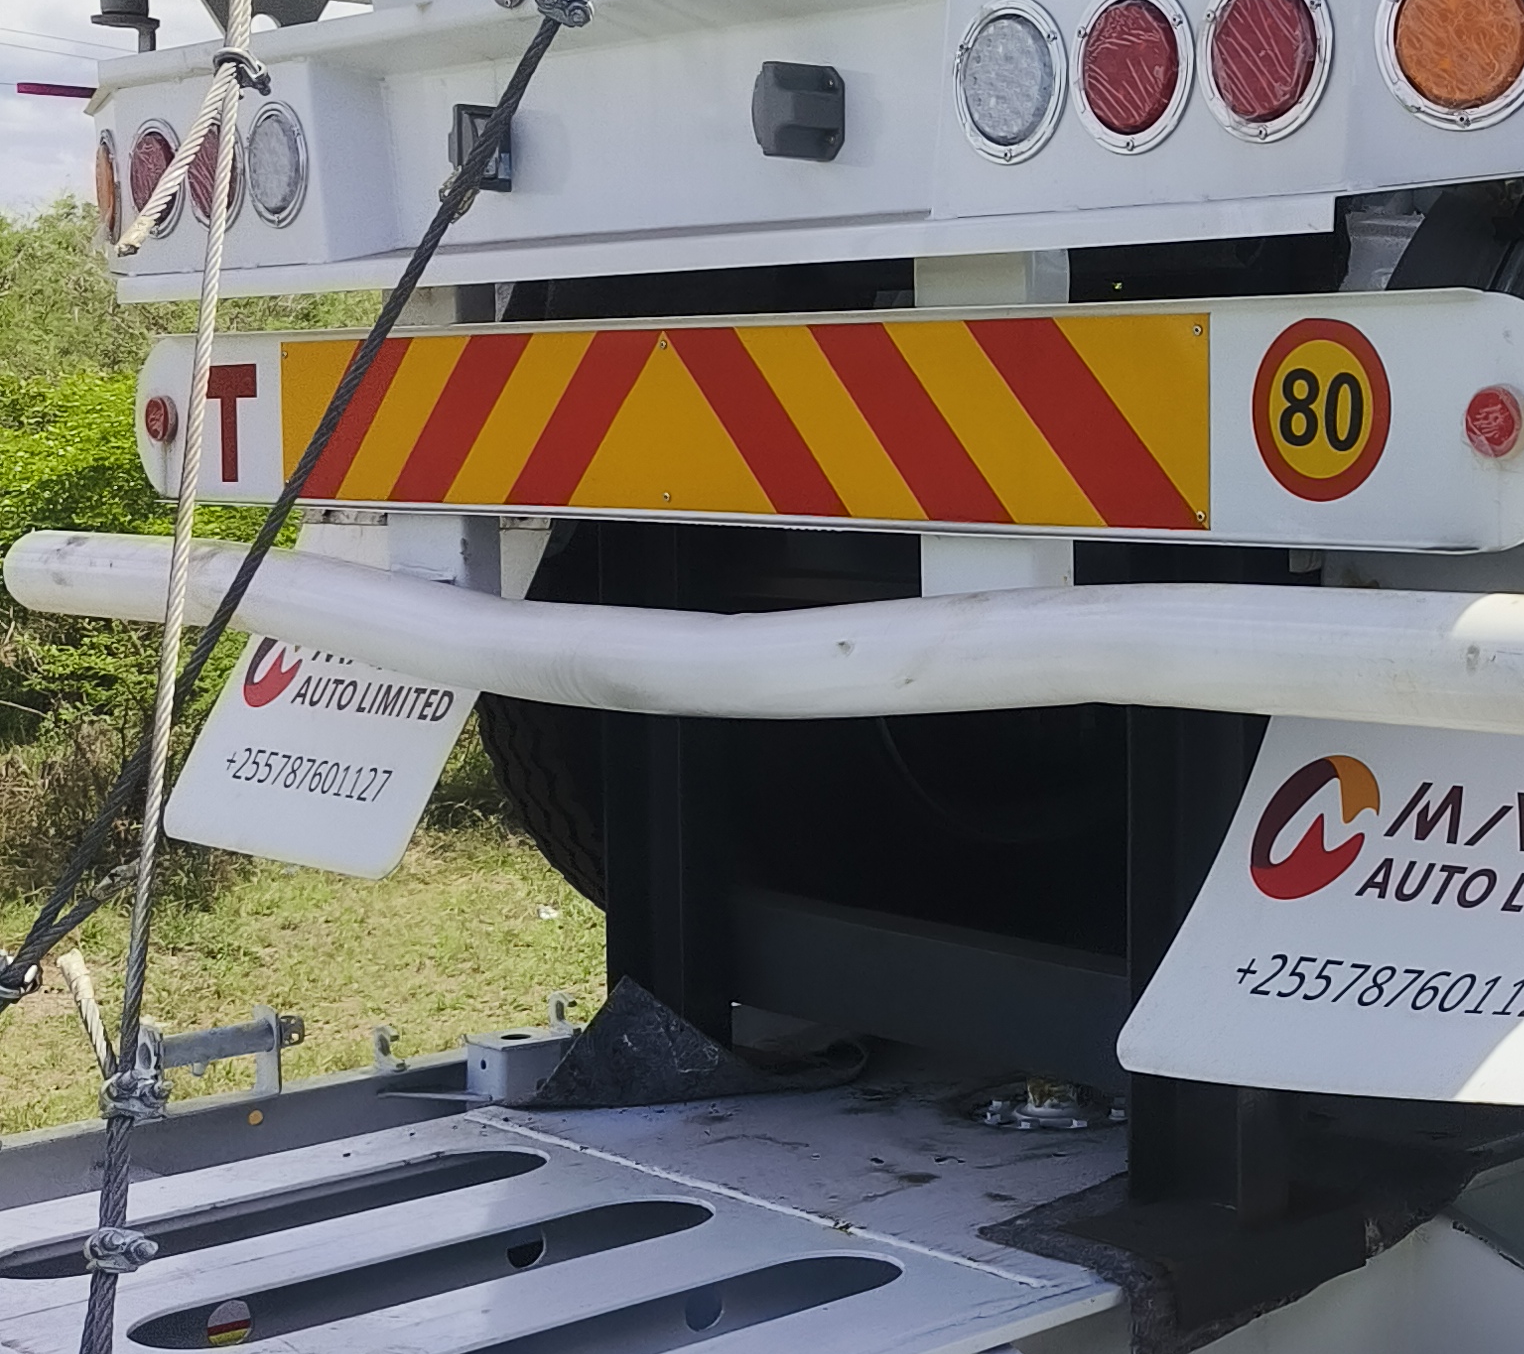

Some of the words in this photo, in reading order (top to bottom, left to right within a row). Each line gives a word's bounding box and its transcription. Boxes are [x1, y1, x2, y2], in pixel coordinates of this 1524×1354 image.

[206, 362, 258, 484] T
[1277, 366, 1367, 454] 80
[290, 675, 358, 711] AUTO
[355, 681, 455, 722] LIMITED
[225, 747, 394, 803] +255787601127
[1354, 857, 1498, 909] AUTO
